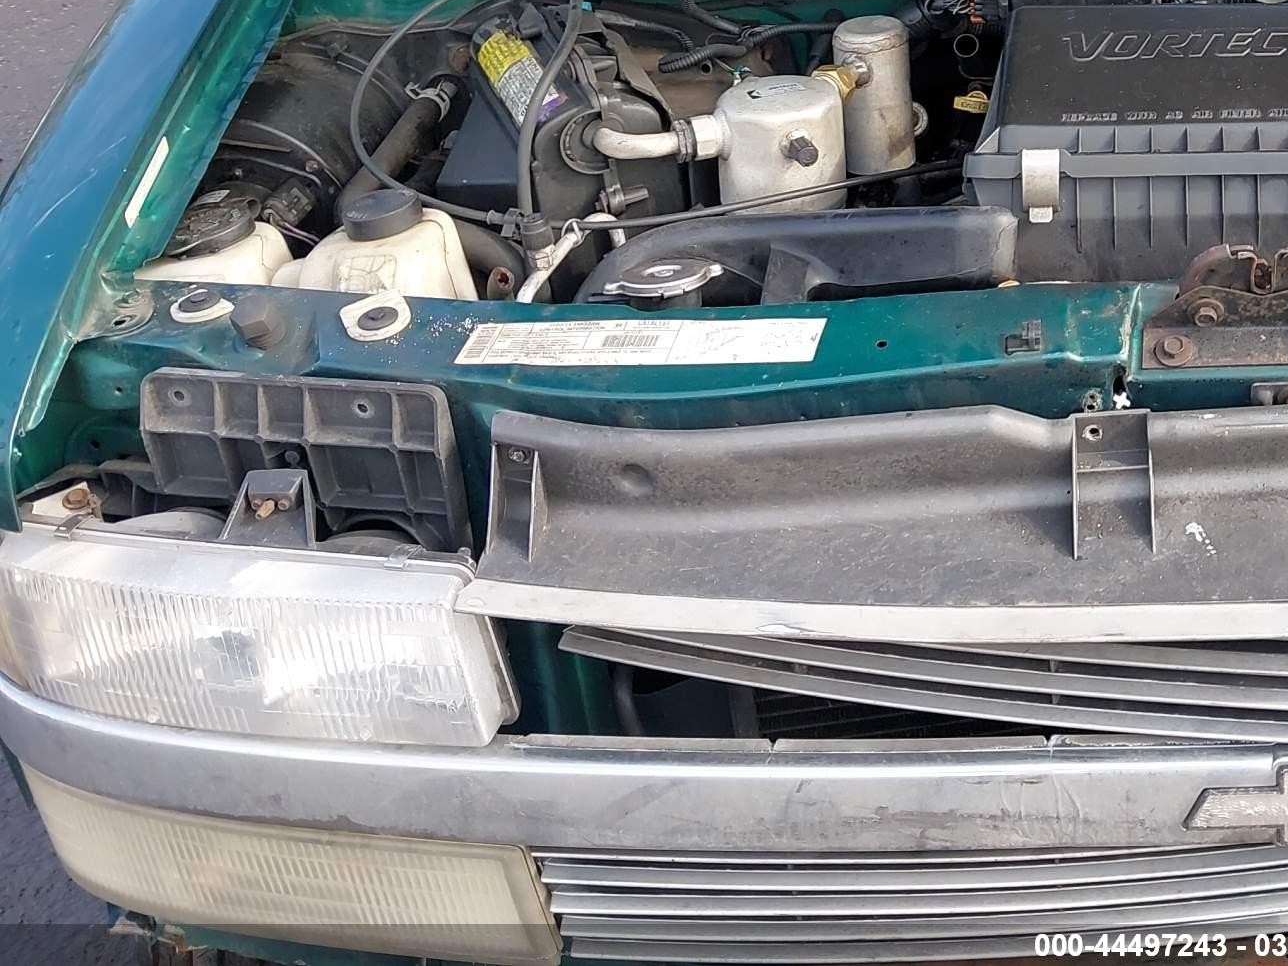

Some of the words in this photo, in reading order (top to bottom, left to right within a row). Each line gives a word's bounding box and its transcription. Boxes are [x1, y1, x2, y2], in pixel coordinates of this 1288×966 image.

[1060, 111, 1119, 122] REPLACE
[1126, 110, 1157, 121] WITH
[1191, 109, 1213, 119] AIR
[1219, 108, 1261, 119] FILTER
